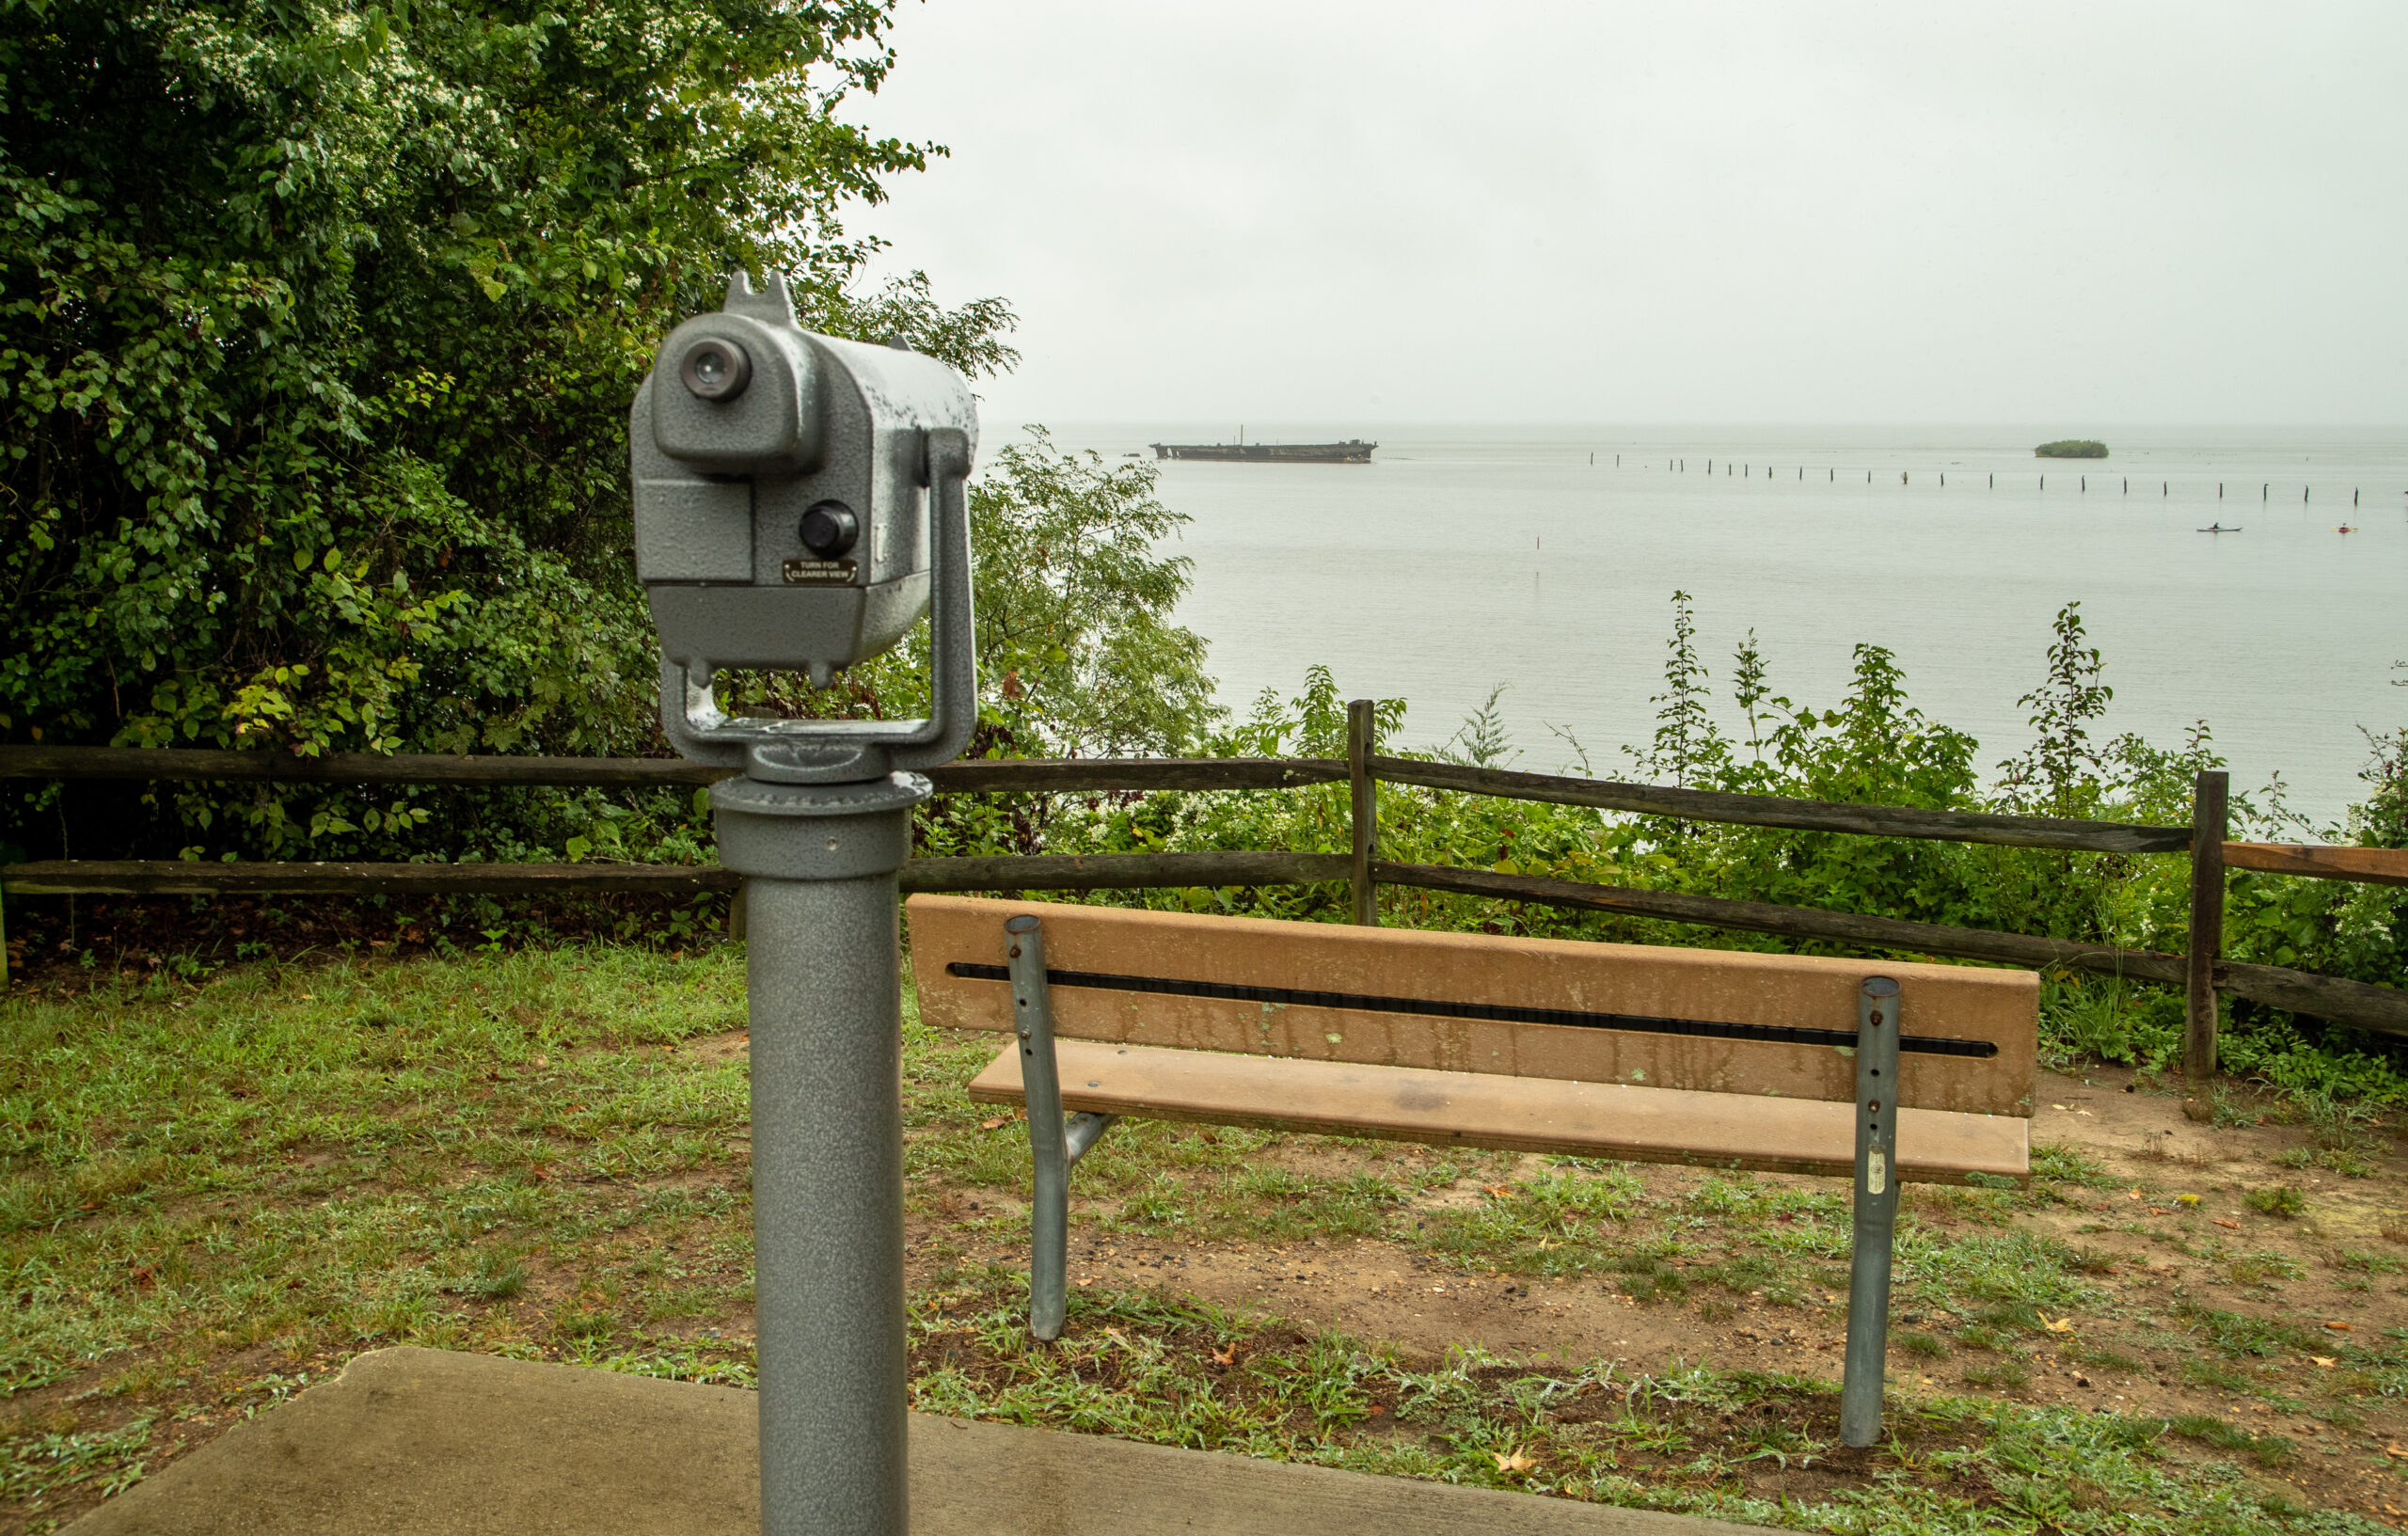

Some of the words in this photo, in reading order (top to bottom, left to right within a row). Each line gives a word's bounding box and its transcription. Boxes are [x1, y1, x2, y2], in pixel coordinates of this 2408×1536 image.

[800, 561, 821, 569] TURN
[823, 561, 840, 569] FOR
[791, 570, 828, 578] CLEARER
[829, 570, 849, 578] VIEW
